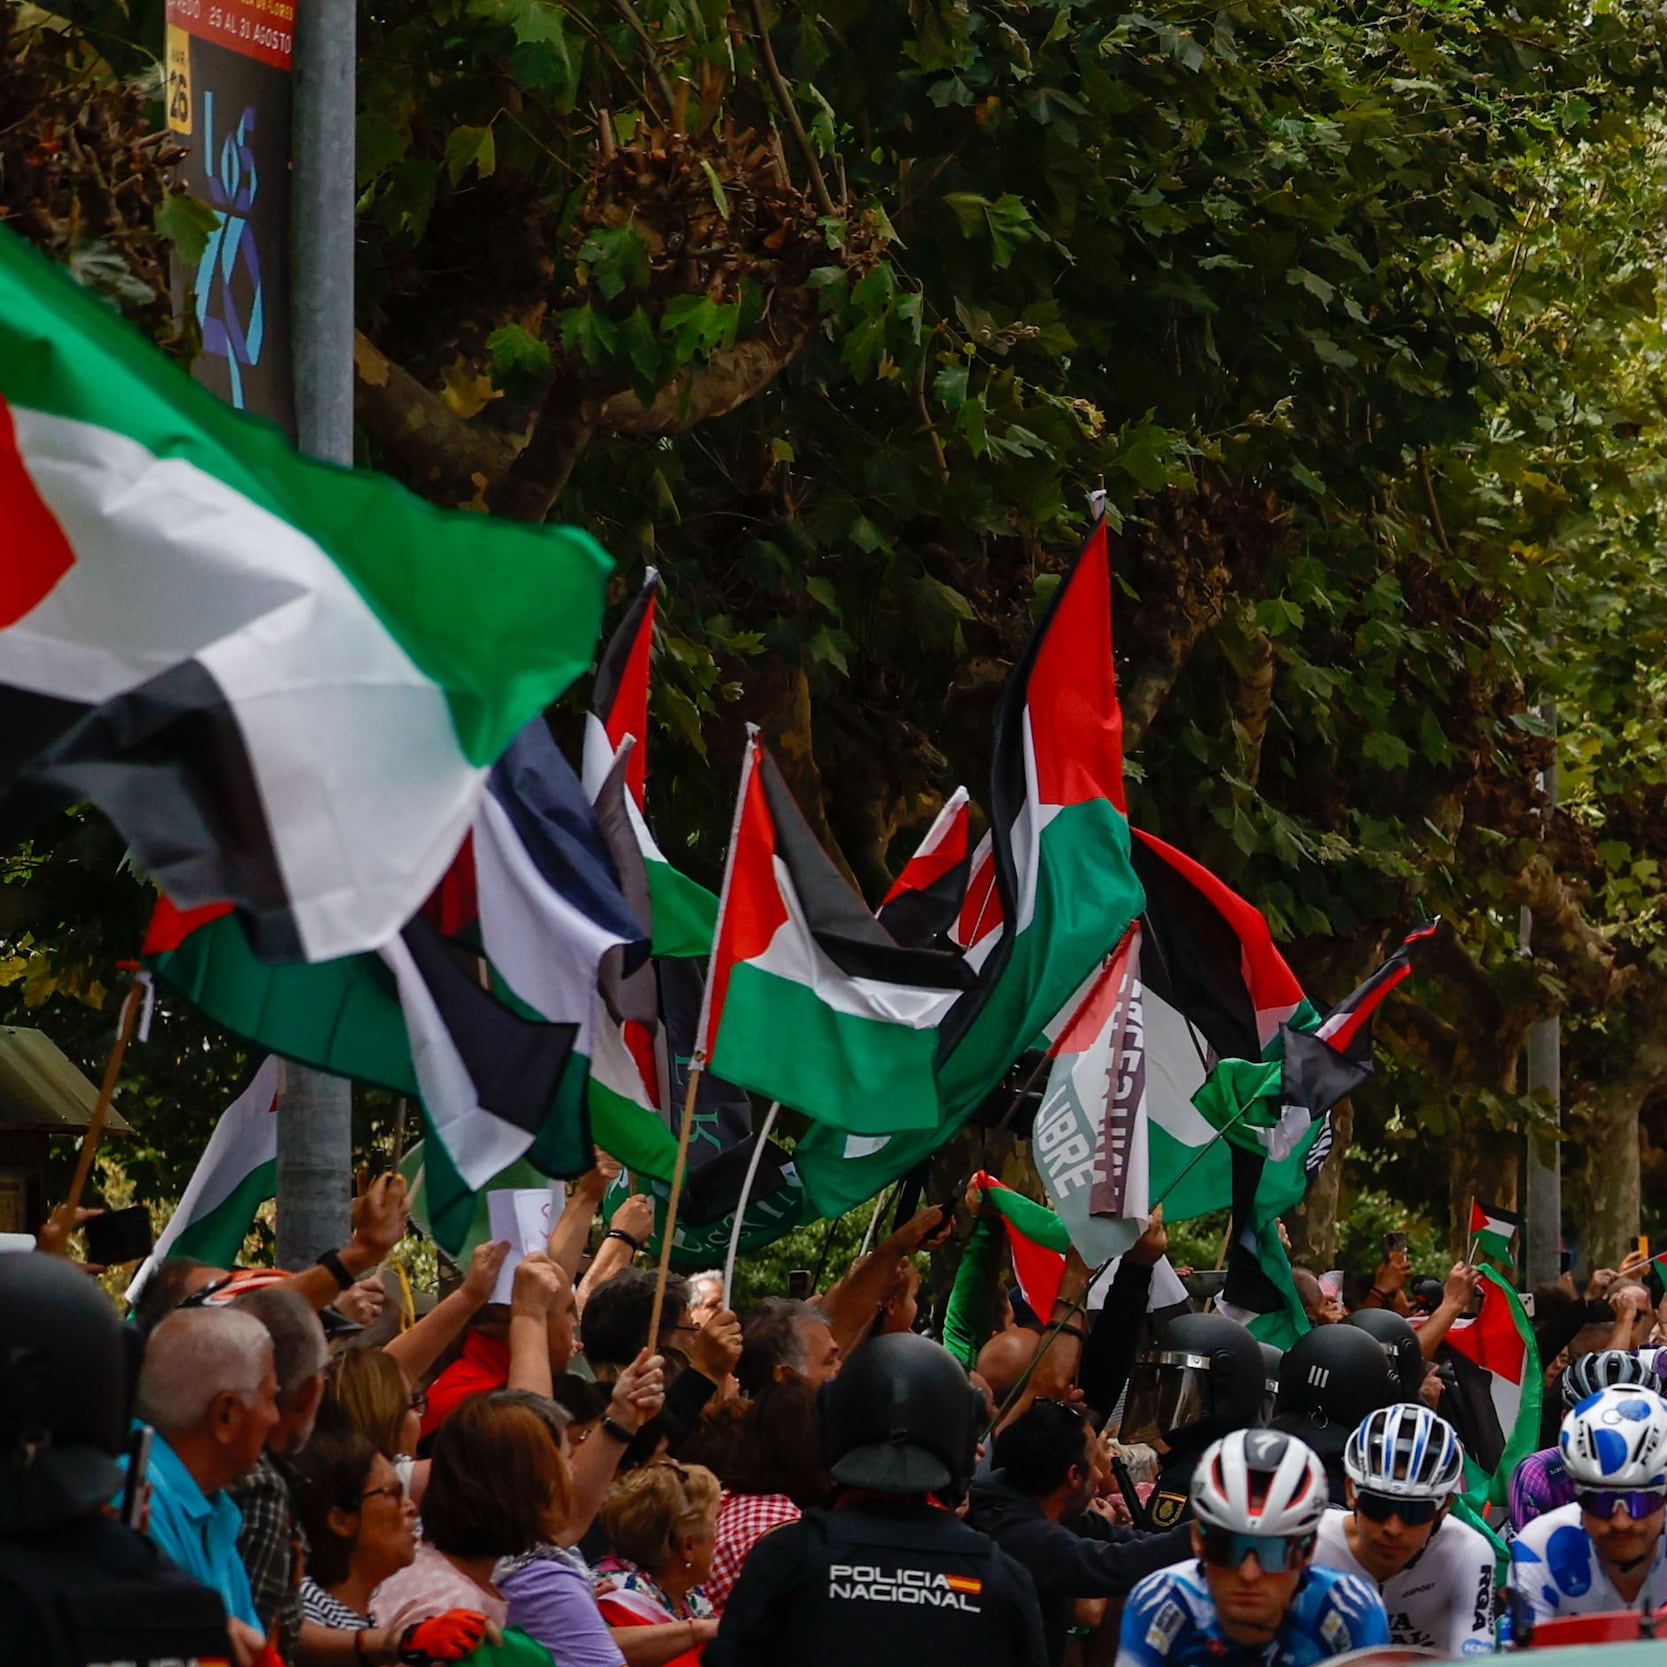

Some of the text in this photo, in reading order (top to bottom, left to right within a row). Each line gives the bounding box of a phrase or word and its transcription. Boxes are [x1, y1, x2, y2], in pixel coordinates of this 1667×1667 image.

[253, 23, 292, 54] AGOSTO
[1036, 1083, 1099, 1199] LIBRE
[829, 1564, 950, 1590] POLICIA
[829, 1583, 982, 1613] NACIONAL
